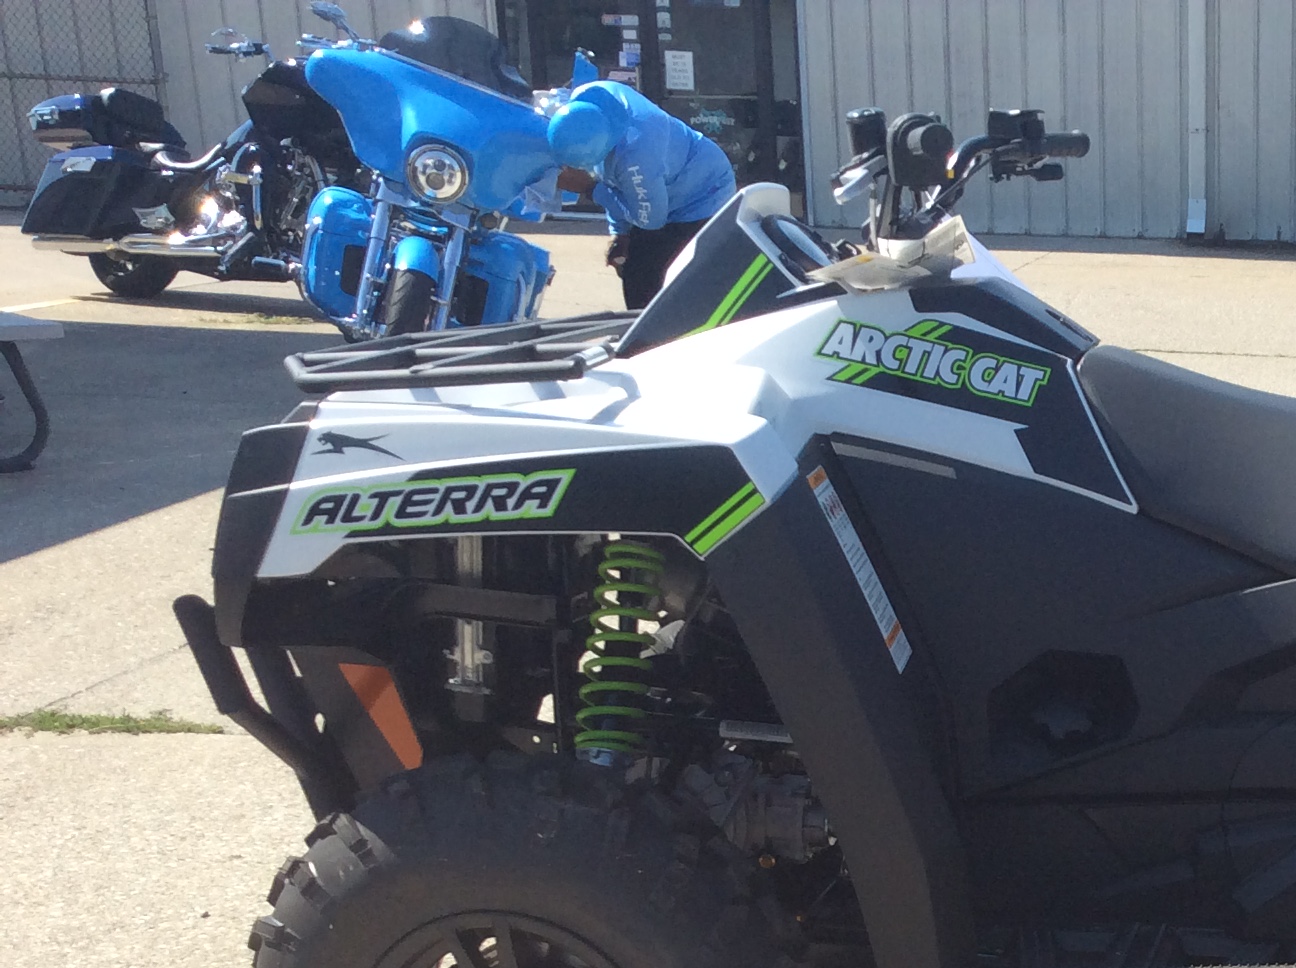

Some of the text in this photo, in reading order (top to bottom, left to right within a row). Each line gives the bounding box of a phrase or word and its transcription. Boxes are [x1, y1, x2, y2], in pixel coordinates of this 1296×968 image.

[820, 322, 1046, 401] ARCTIC CAT
[300, 475, 564, 527] ALTERRA
